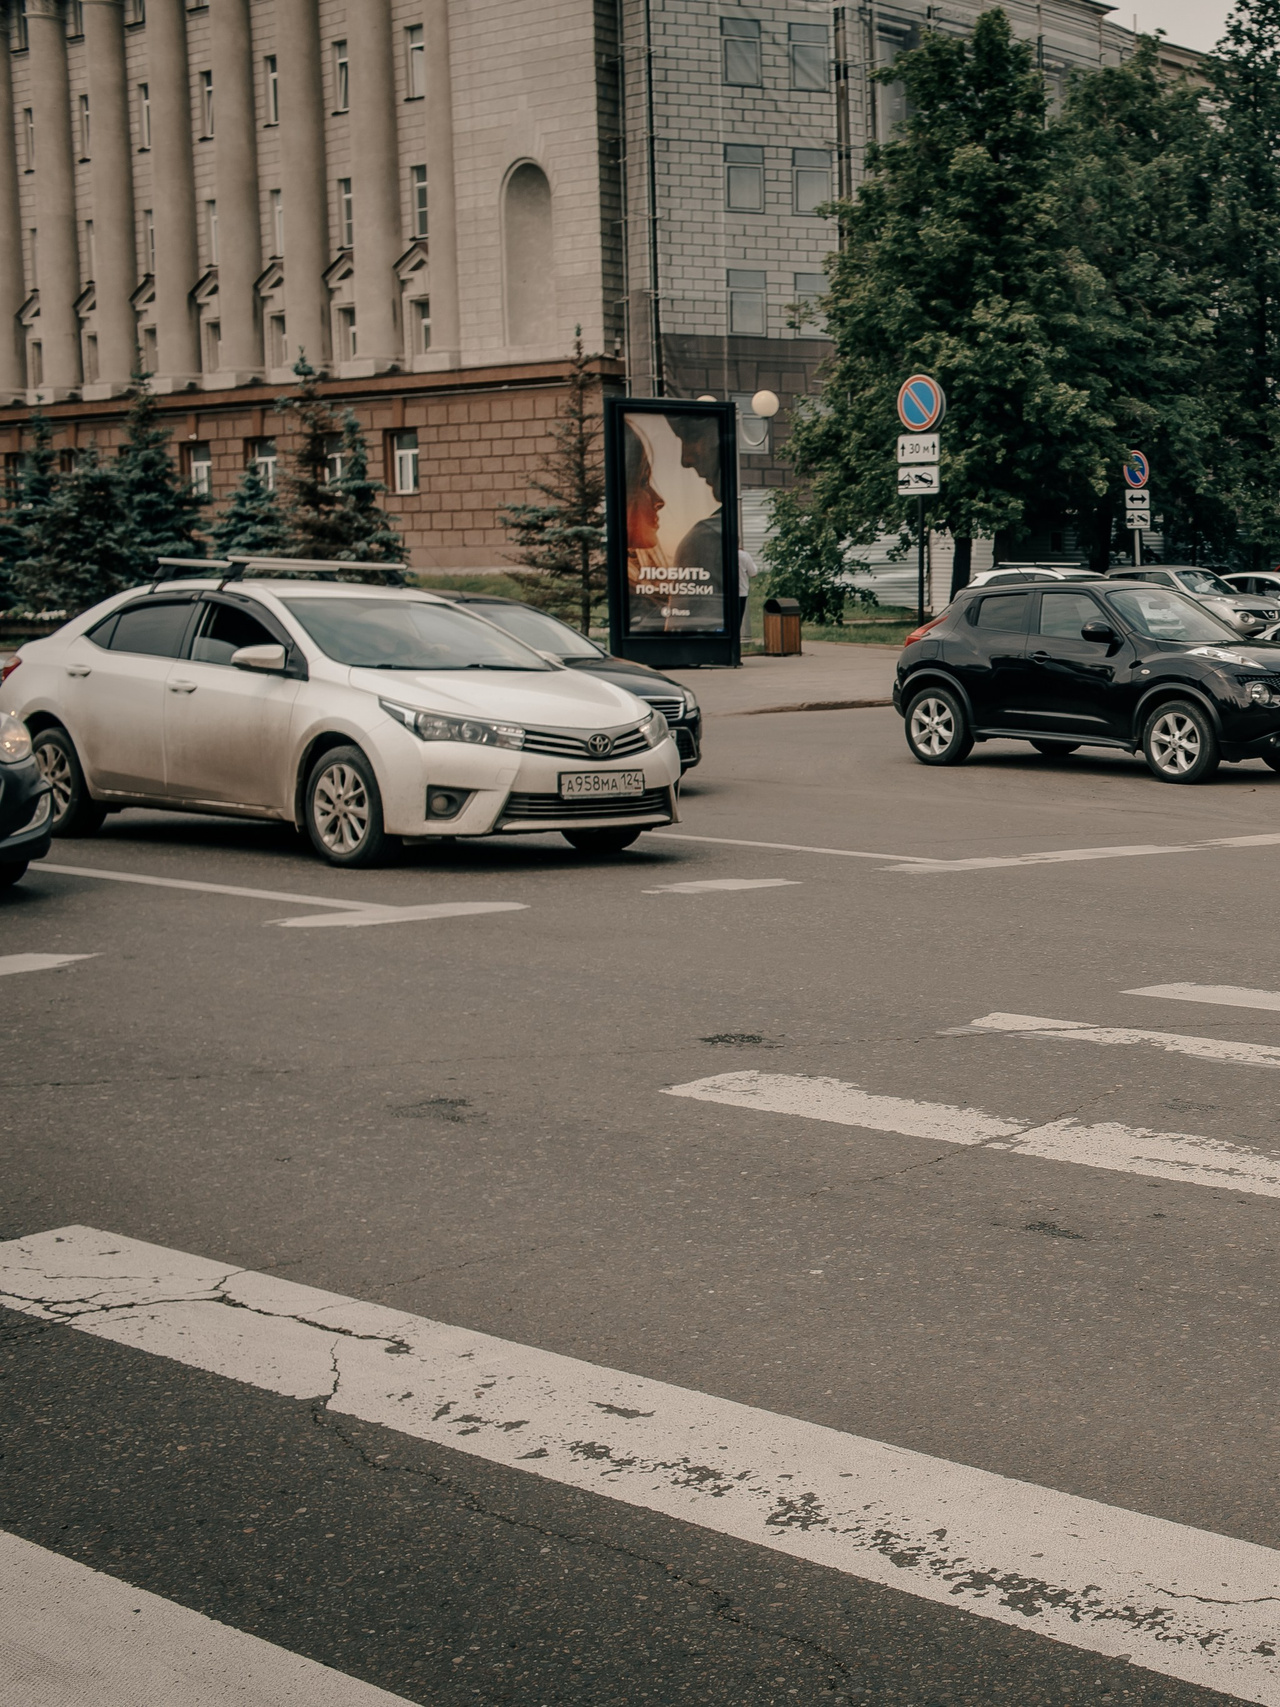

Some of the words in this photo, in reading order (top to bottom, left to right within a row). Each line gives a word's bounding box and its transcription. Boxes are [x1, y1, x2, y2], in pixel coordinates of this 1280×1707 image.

[909, 443, 920, 454] 30
[638, 567, 711, 580] ЛЮБИТЬ
[635, 583, 714, 595] по-RUSSки
[671, 608, 691, 617] Russ
[620, 773, 641, 786] 124
